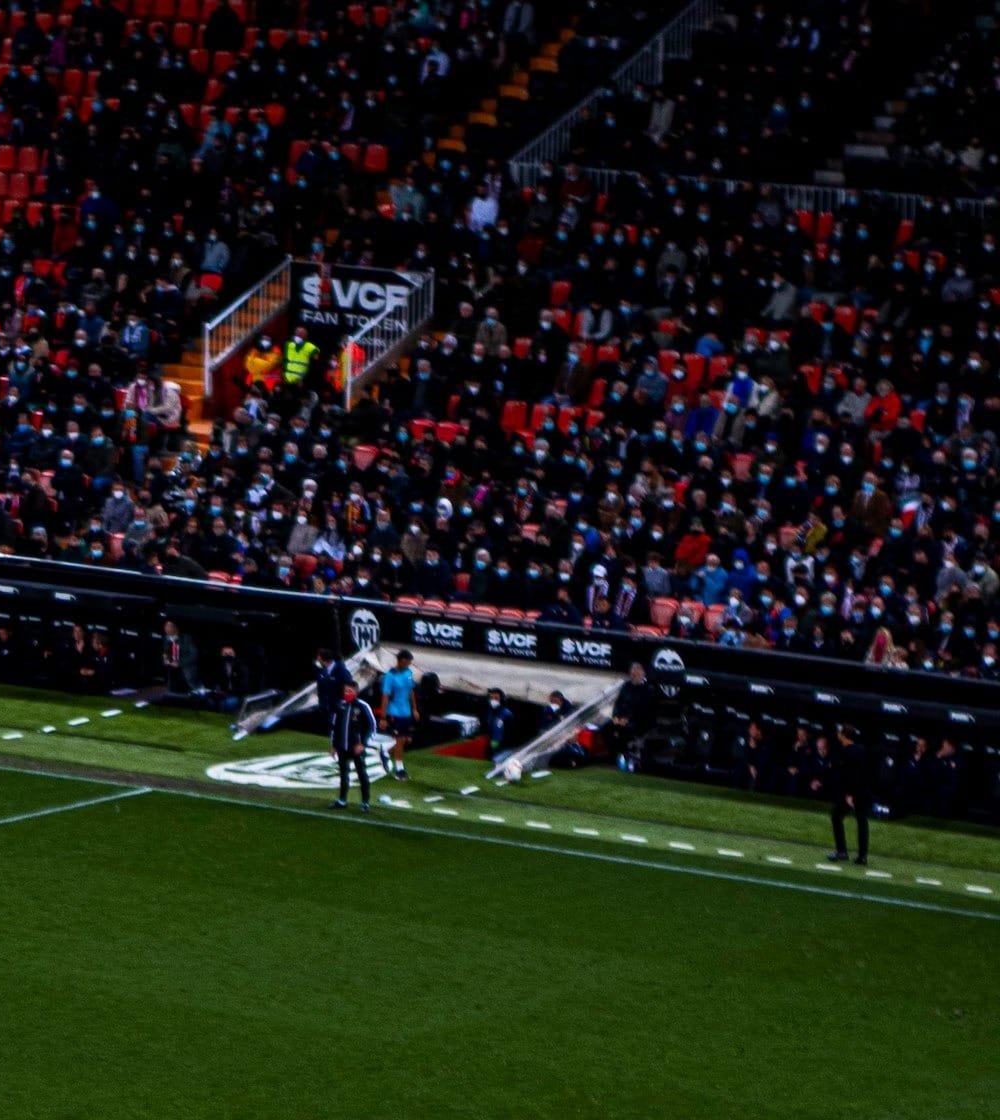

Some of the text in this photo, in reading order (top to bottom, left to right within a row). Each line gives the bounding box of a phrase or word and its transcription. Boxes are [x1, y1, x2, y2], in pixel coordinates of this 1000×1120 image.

[302, 309, 409, 334] FAN TOEN
[413, 620, 464, 638] $VCF
[487, 629, 538, 648] $VCF
[561, 638, 612, 657] $VCF
